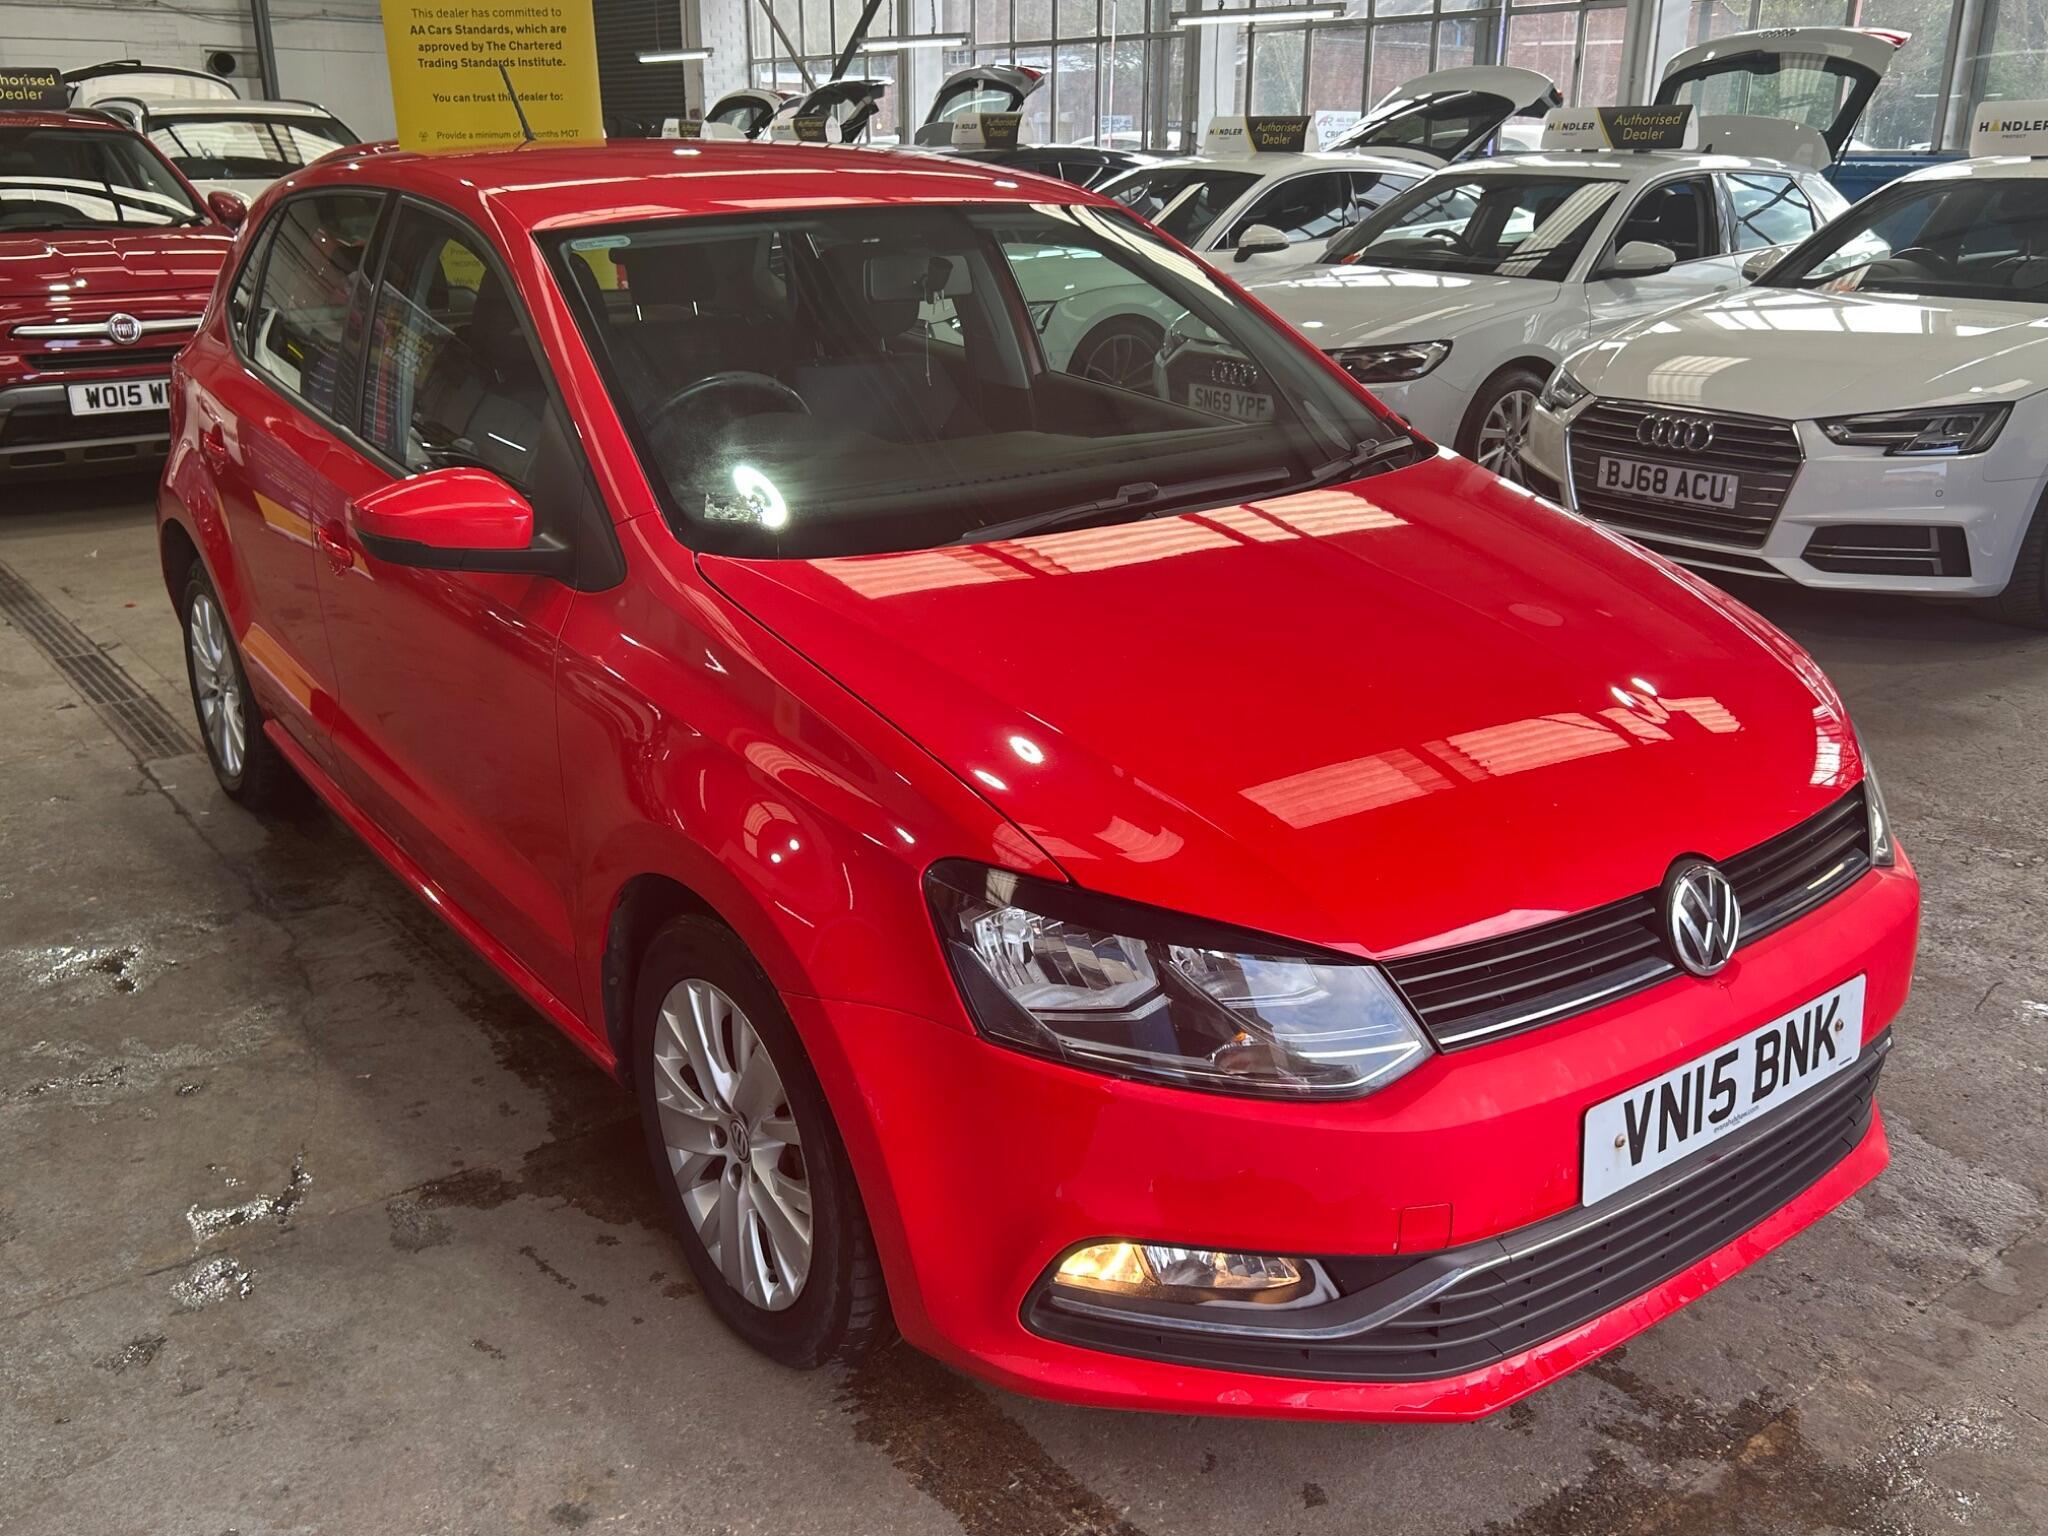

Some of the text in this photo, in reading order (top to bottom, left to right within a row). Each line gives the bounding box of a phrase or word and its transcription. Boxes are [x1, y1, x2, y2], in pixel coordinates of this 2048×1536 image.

[411, 7, 562, 18] This dealer has committed to
[409, 25, 567, 36] AA Cars Standards, which are
[418, 41, 562, 53] approved by The Chartered
[418, 57, 566, 70] Trading Standards Institute.
[432, 92, 564, 103] You can trust thi dealer to:
[1614, 112, 1683, 127] Authorised
[1255, 121, 1305, 132] Authorised
[436, 131, 468, 140] Provide
[475, 131, 511, 139] minimum
[512, 130, 522, 139] of
[560, 129, 579, 138] MOT
[1261, 133, 1292, 145] Dealer
[1622, 127, 1665, 141] Dealer
[1194, 387, 1232, 413] SN69
[1605, 460, 1728, 503] BJ68 ACU
[1624, 995, 1840, 1167] VN15 BNK
